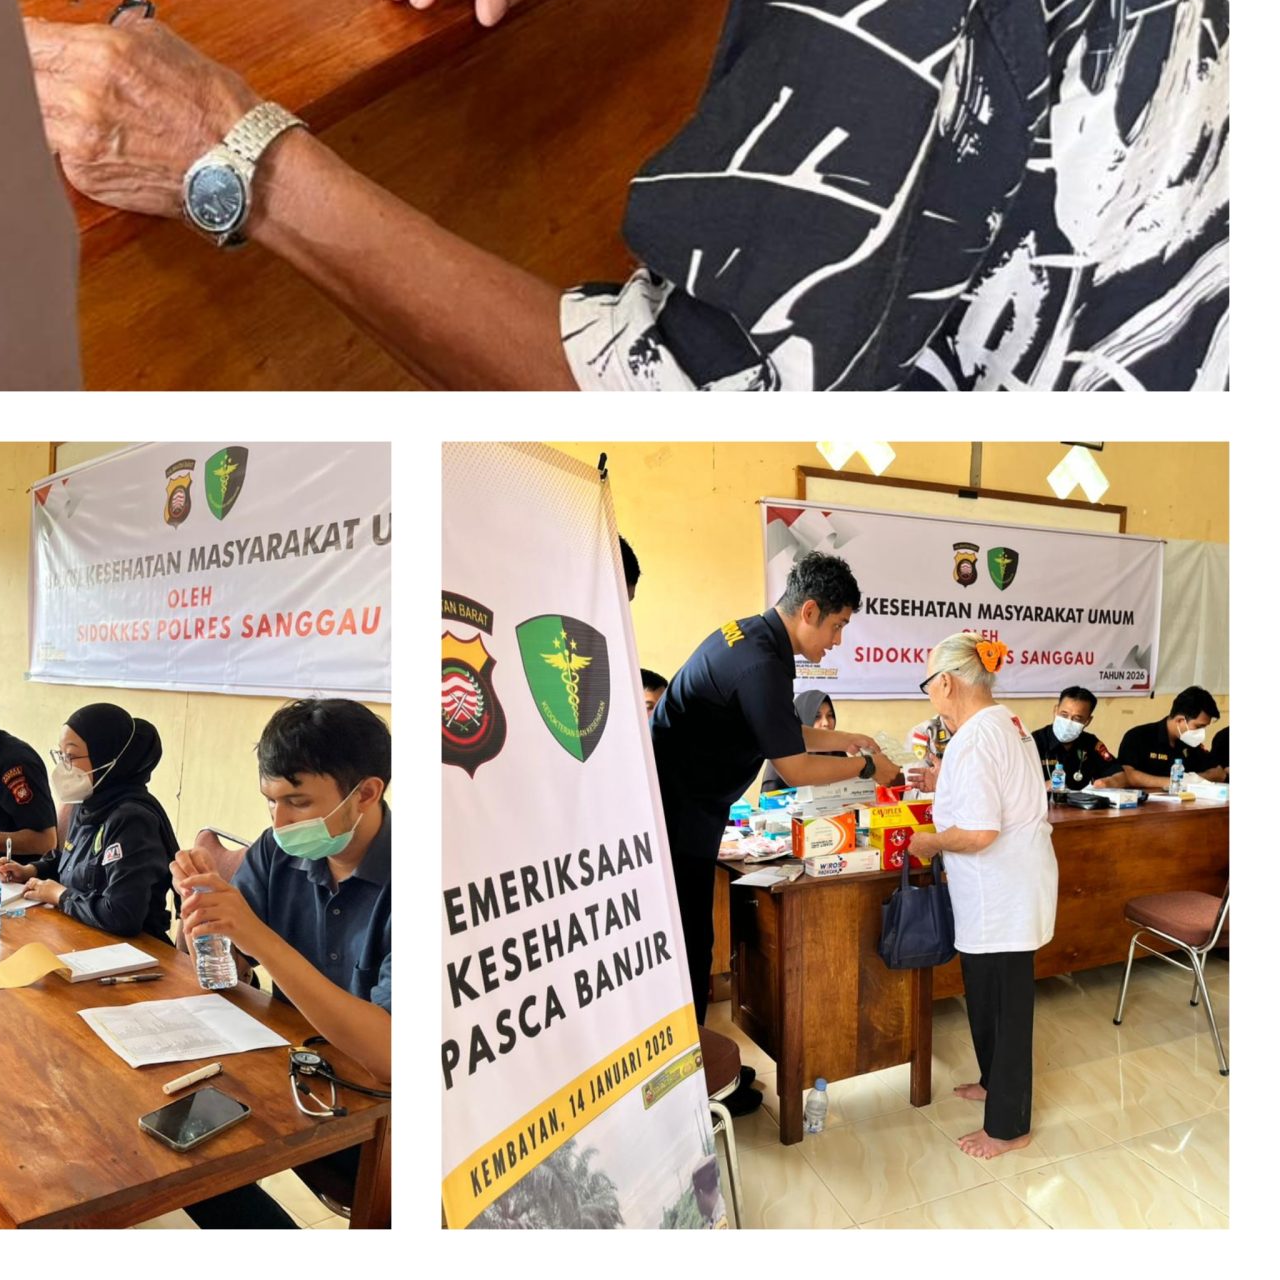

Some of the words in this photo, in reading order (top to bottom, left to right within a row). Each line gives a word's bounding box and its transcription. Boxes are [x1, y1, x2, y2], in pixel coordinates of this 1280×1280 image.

[86, 550, 182, 587] KESEHATAN
[187, 518, 361, 573] MASYARAKAT
[167, 586, 213, 609] OLEH
[865, 597, 972, 619] KESEHATAN
[977, 603, 1084, 624] MASYARAKAT
[1088, 608, 1135, 625] UMUM
[77, 620, 150, 642] SIDOKKES
[156, 616, 231, 641] POLRES
[241, 606, 383, 639] SANGGAU
[458, 603, 488, 627] BARAT
[961, 629, 999, 643] EH
[854, 646, 933, 664] SIDOKK
[1020, 649, 1095, 666] SANGGAU
[1099, 671, 1125, 680] TAHUN
[1126, 671, 1145, 680] 2026
[442, 831, 654, 936] EMERIKSAAN
[446, 888, 642, 1009] KESEHATAN
[442, 984, 567, 1091] PASCA
[574, 930, 672, 1010] BANJIR
[470, 1108, 567, 1198] KEMBAYAN,
[569, 1093, 586, 1119] 14
[589, 1048, 643, 1104] JANUARI
[645, 1025, 674, 1062] 2026
